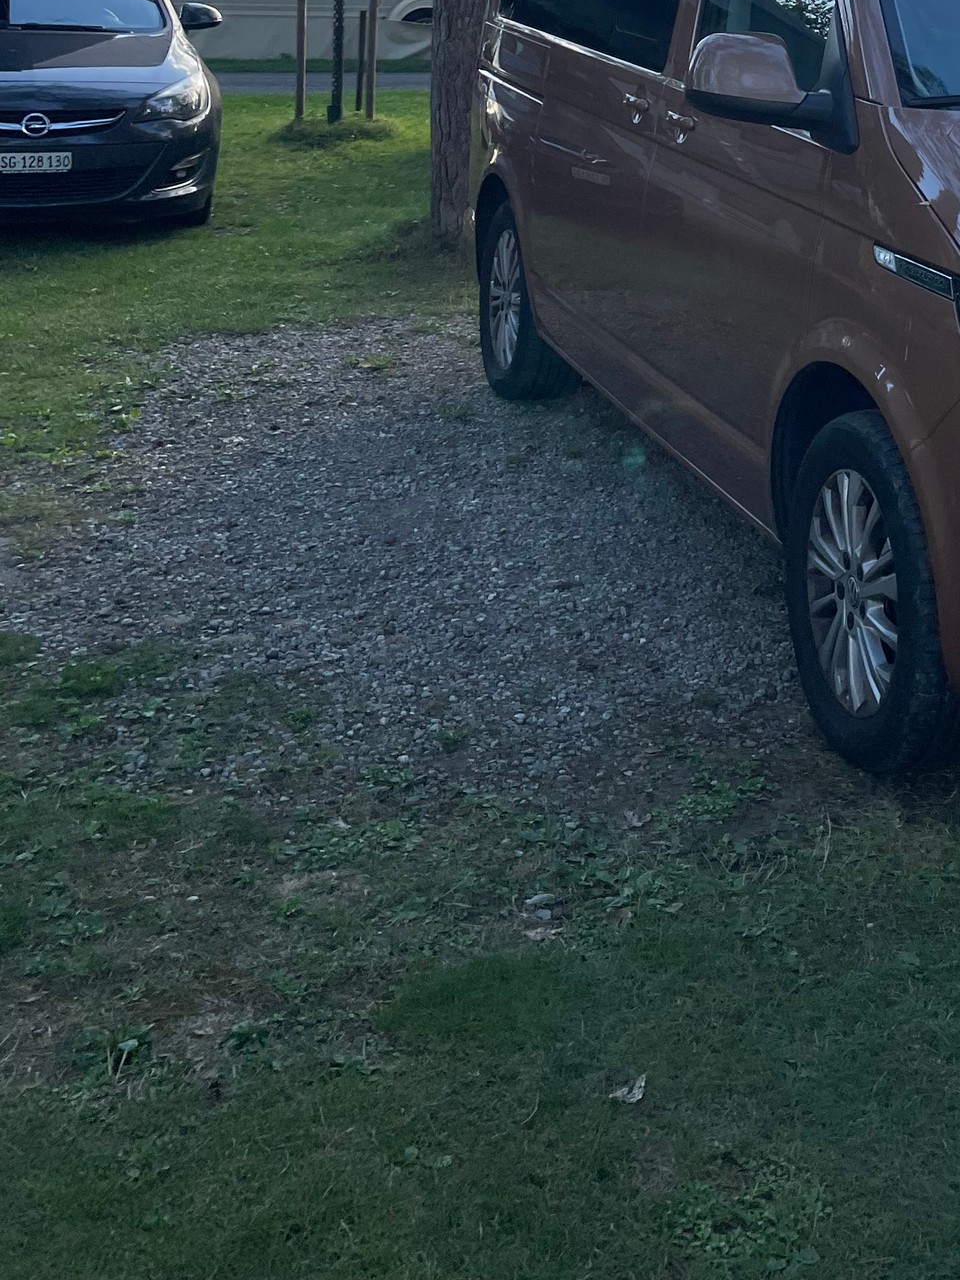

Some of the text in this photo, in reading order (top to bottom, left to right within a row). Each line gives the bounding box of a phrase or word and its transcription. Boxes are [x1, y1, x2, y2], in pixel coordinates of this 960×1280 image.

[1, 155, 70, 168] SG 128 130
